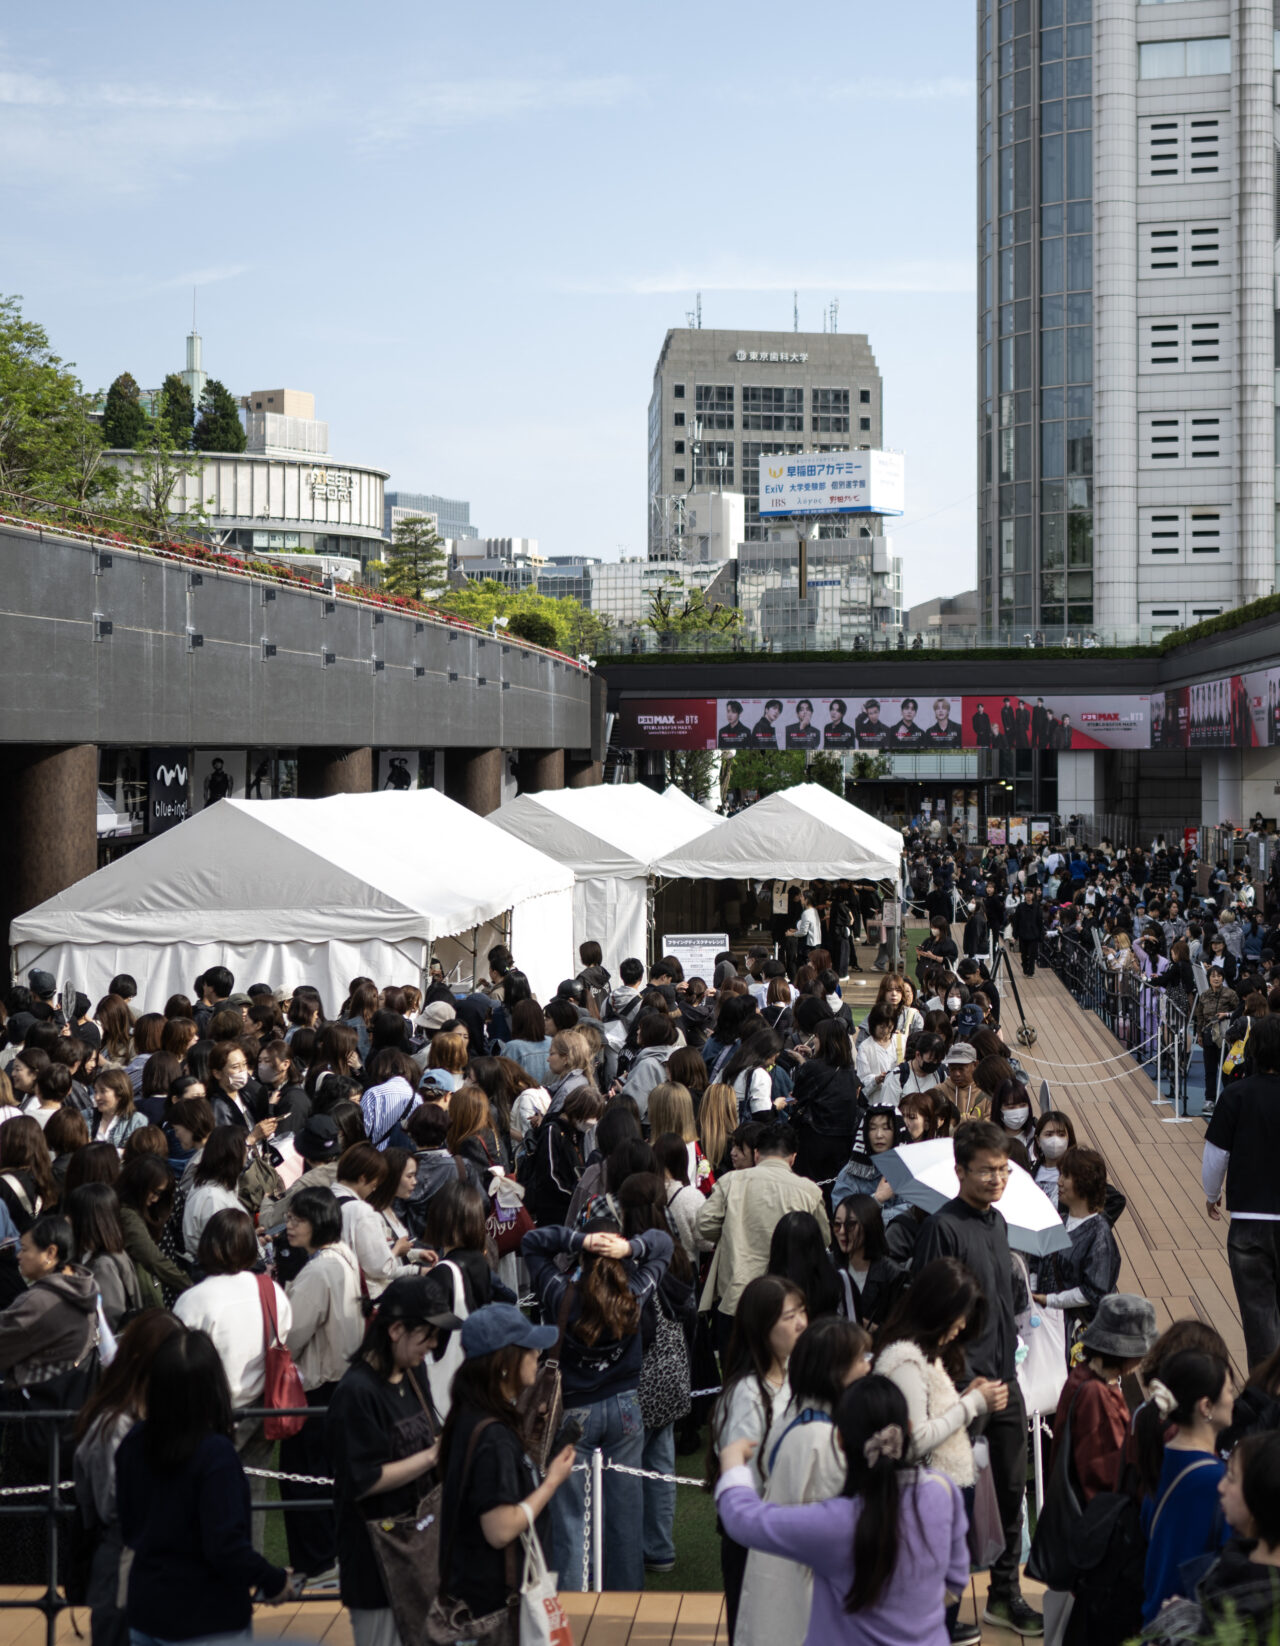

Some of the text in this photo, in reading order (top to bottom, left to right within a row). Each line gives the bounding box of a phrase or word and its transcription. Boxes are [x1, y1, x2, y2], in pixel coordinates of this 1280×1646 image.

[748, 351, 809, 362] 東京歯科大学
[787, 462, 862, 478] 早稲田アカデミー
[765, 484, 784, 494] ExiV
[790, 482, 826, 492] 大学受験部
[654, 716, 675, 724] MAX
[685, 716, 698, 724] BTS
